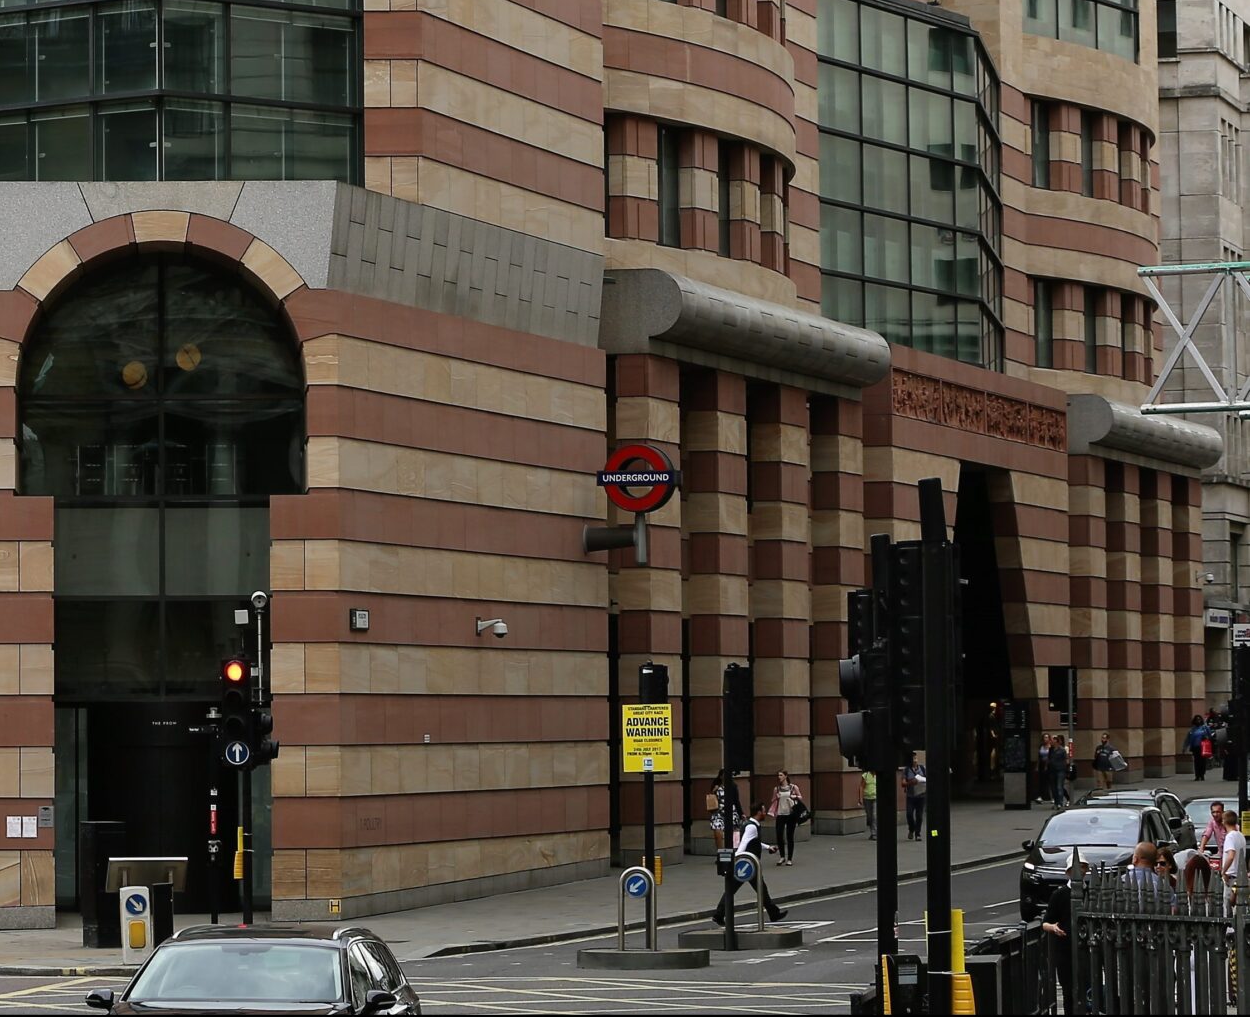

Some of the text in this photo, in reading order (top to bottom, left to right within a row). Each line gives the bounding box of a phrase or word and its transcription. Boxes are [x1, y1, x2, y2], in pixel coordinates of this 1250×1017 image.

[602, 473, 669, 482] UNDERGROUND
[626, 717, 669, 726] ADVANCE
[626, 728, 669, 737] WARNING
